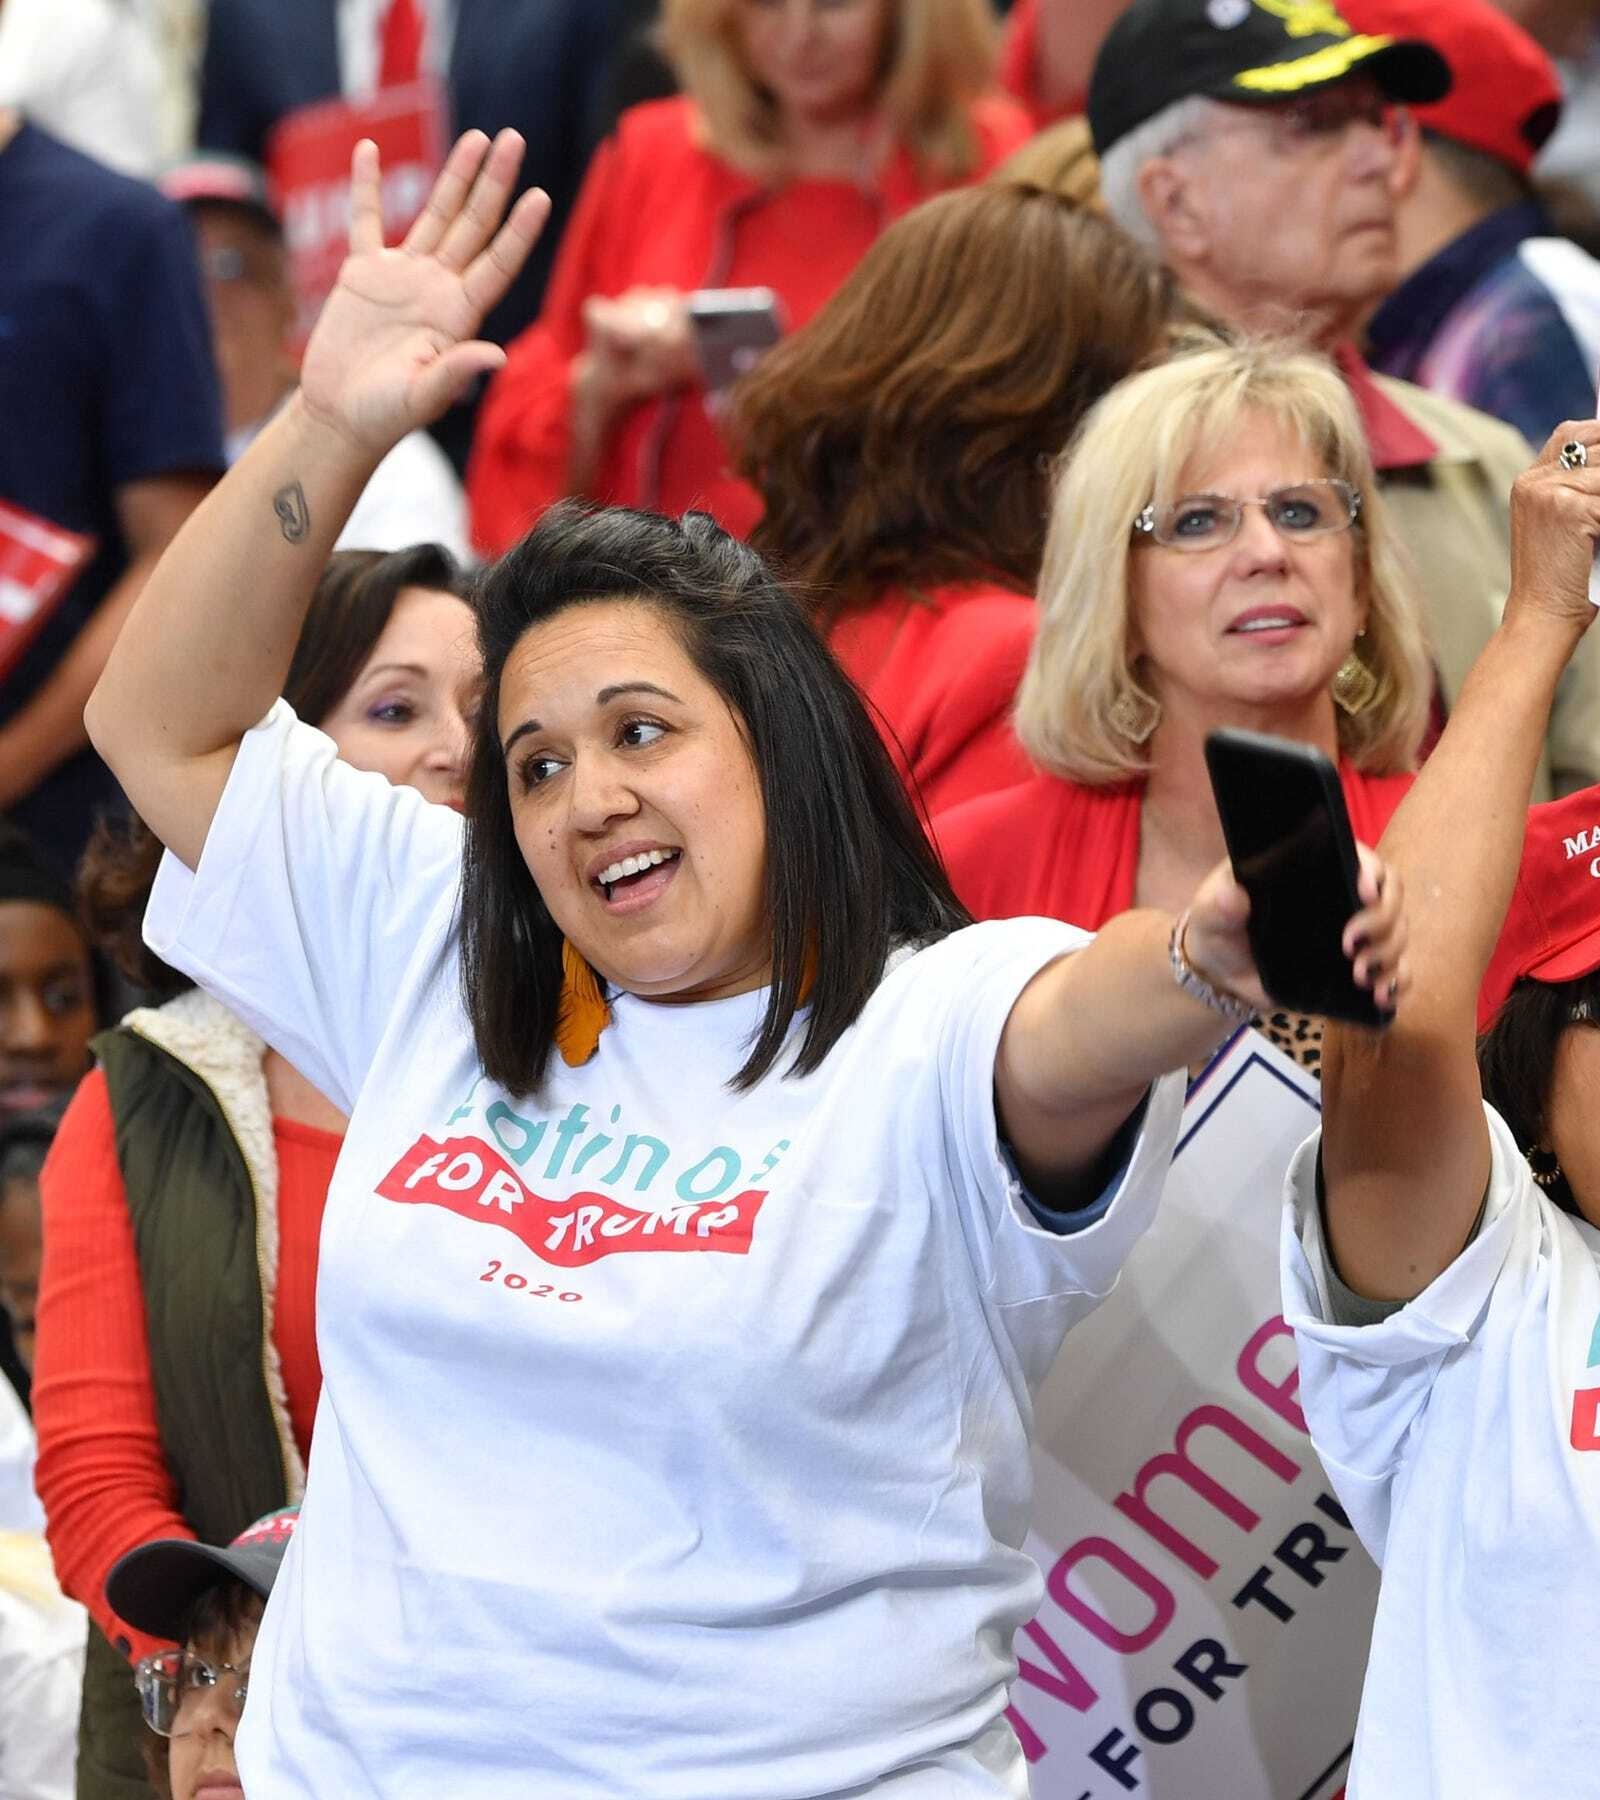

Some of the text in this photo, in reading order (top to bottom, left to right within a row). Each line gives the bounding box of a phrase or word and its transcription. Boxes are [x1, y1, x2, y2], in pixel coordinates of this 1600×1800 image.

[403, 1151, 740, 1252] FOR TRUMP
[479, 1260, 584, 1303] 2020
[1003, 1314, 1312, 1766] wome
[1087, 1638, 1250, 1792] FOR
